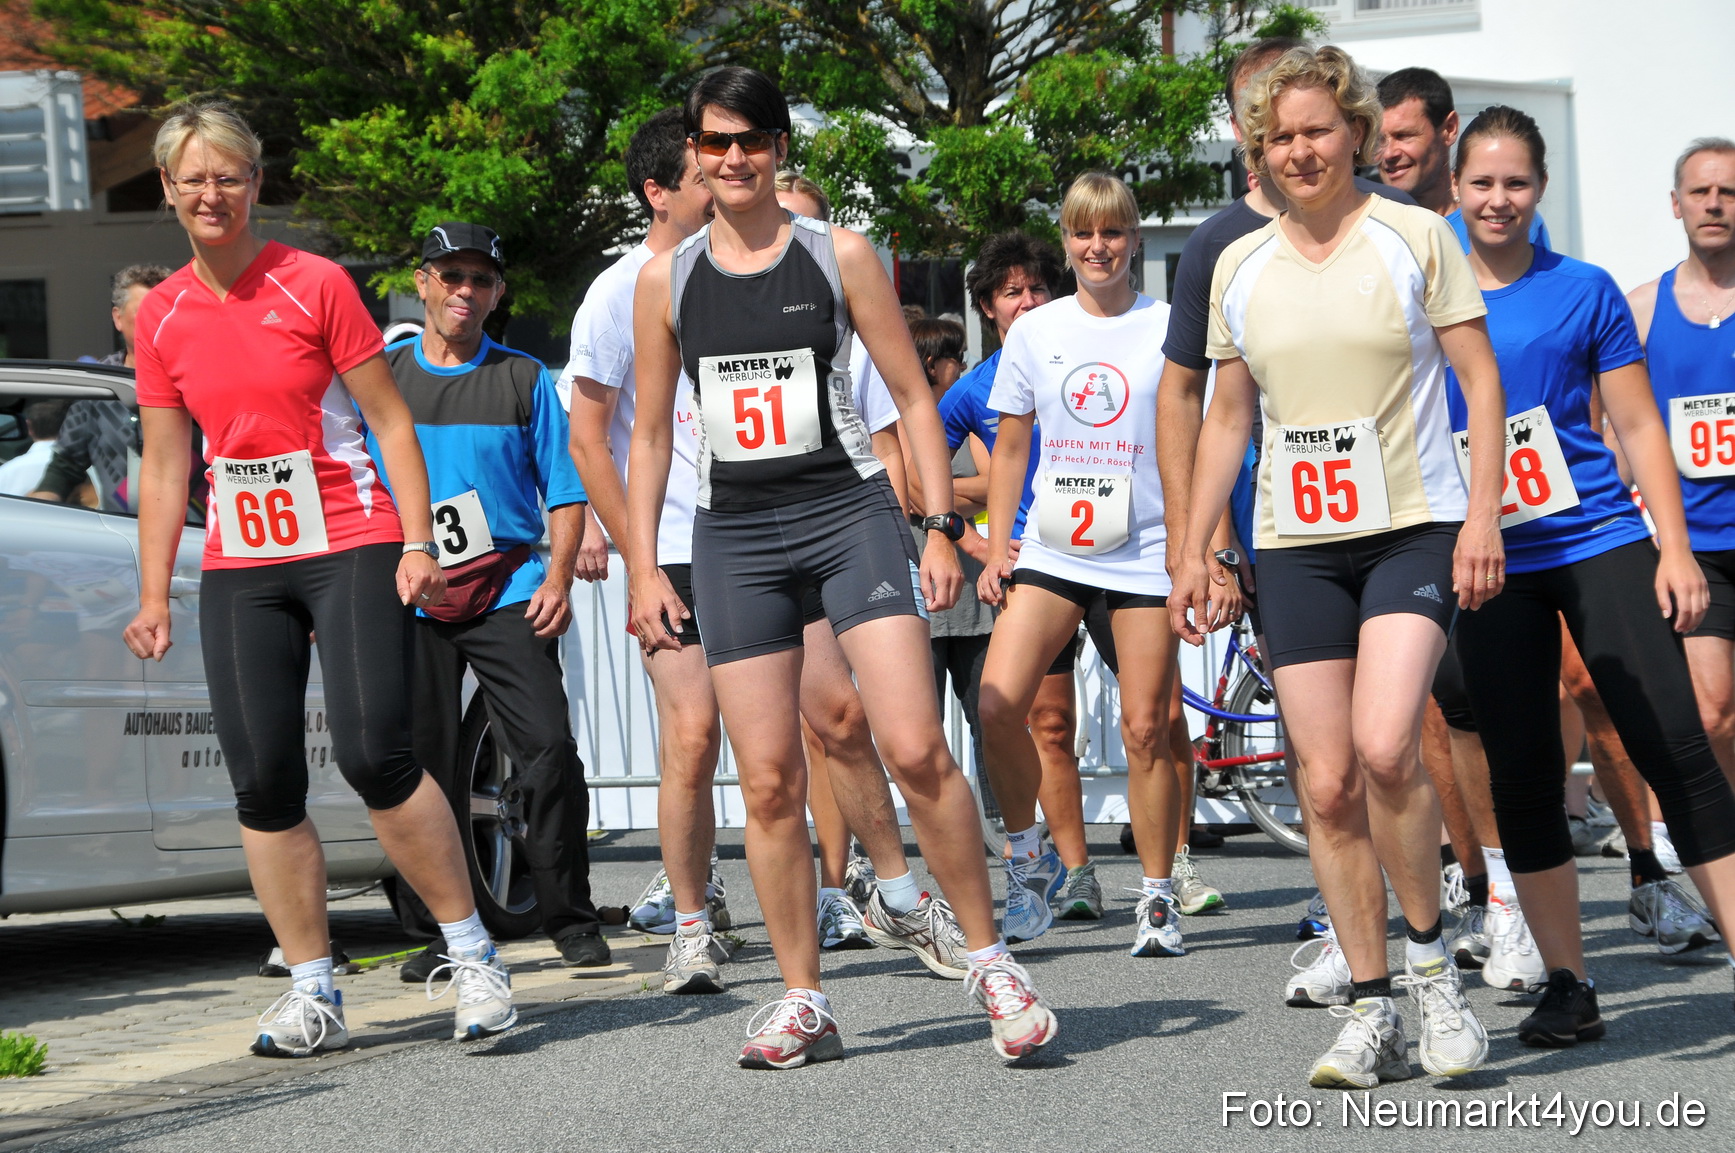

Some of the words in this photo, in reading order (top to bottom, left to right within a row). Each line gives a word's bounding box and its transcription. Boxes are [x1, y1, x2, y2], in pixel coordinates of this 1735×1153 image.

[782, 303, 809, 313] CRAFT
[718, 359, 769, 373] MEYER
[718, 370, 772, 382] WERBUNG
[1683, 398, 1722, 410] MEYER
[733, 385, 787, 450] 51
[1684, 407, 1723, 417] WERBUNG
[1284, 429, 1330, 443] MEYER
[1089, 441, 1111, 451] MIT
[1116, 440, 1145, 455] HERZ
[1284, 443, 1332, 454] WERBUNG
[1691, 419, 1735, 468] 95
[1065, 455, 1085, 464] Heck
[1093, 456, 1105, 465] Dr.
[225, 462, 269, 476] MEYER
[225, 475, 271, 485] WERBUNG
[1055, 477, 1096, 488] MEYER
[1055, 487, 1096, 495] WERBUNG
[1291, 458, 1359, 524] 65
[235, 488, 300, 548] 66
[1071, 499, 1095, 547] 2
[431, 504, 469, 555] 3
[867, 590, 901, 602] adidas
[124, 712, 182, 735] AUTOHAUS
[185, 712, 216, 735] BAUE
